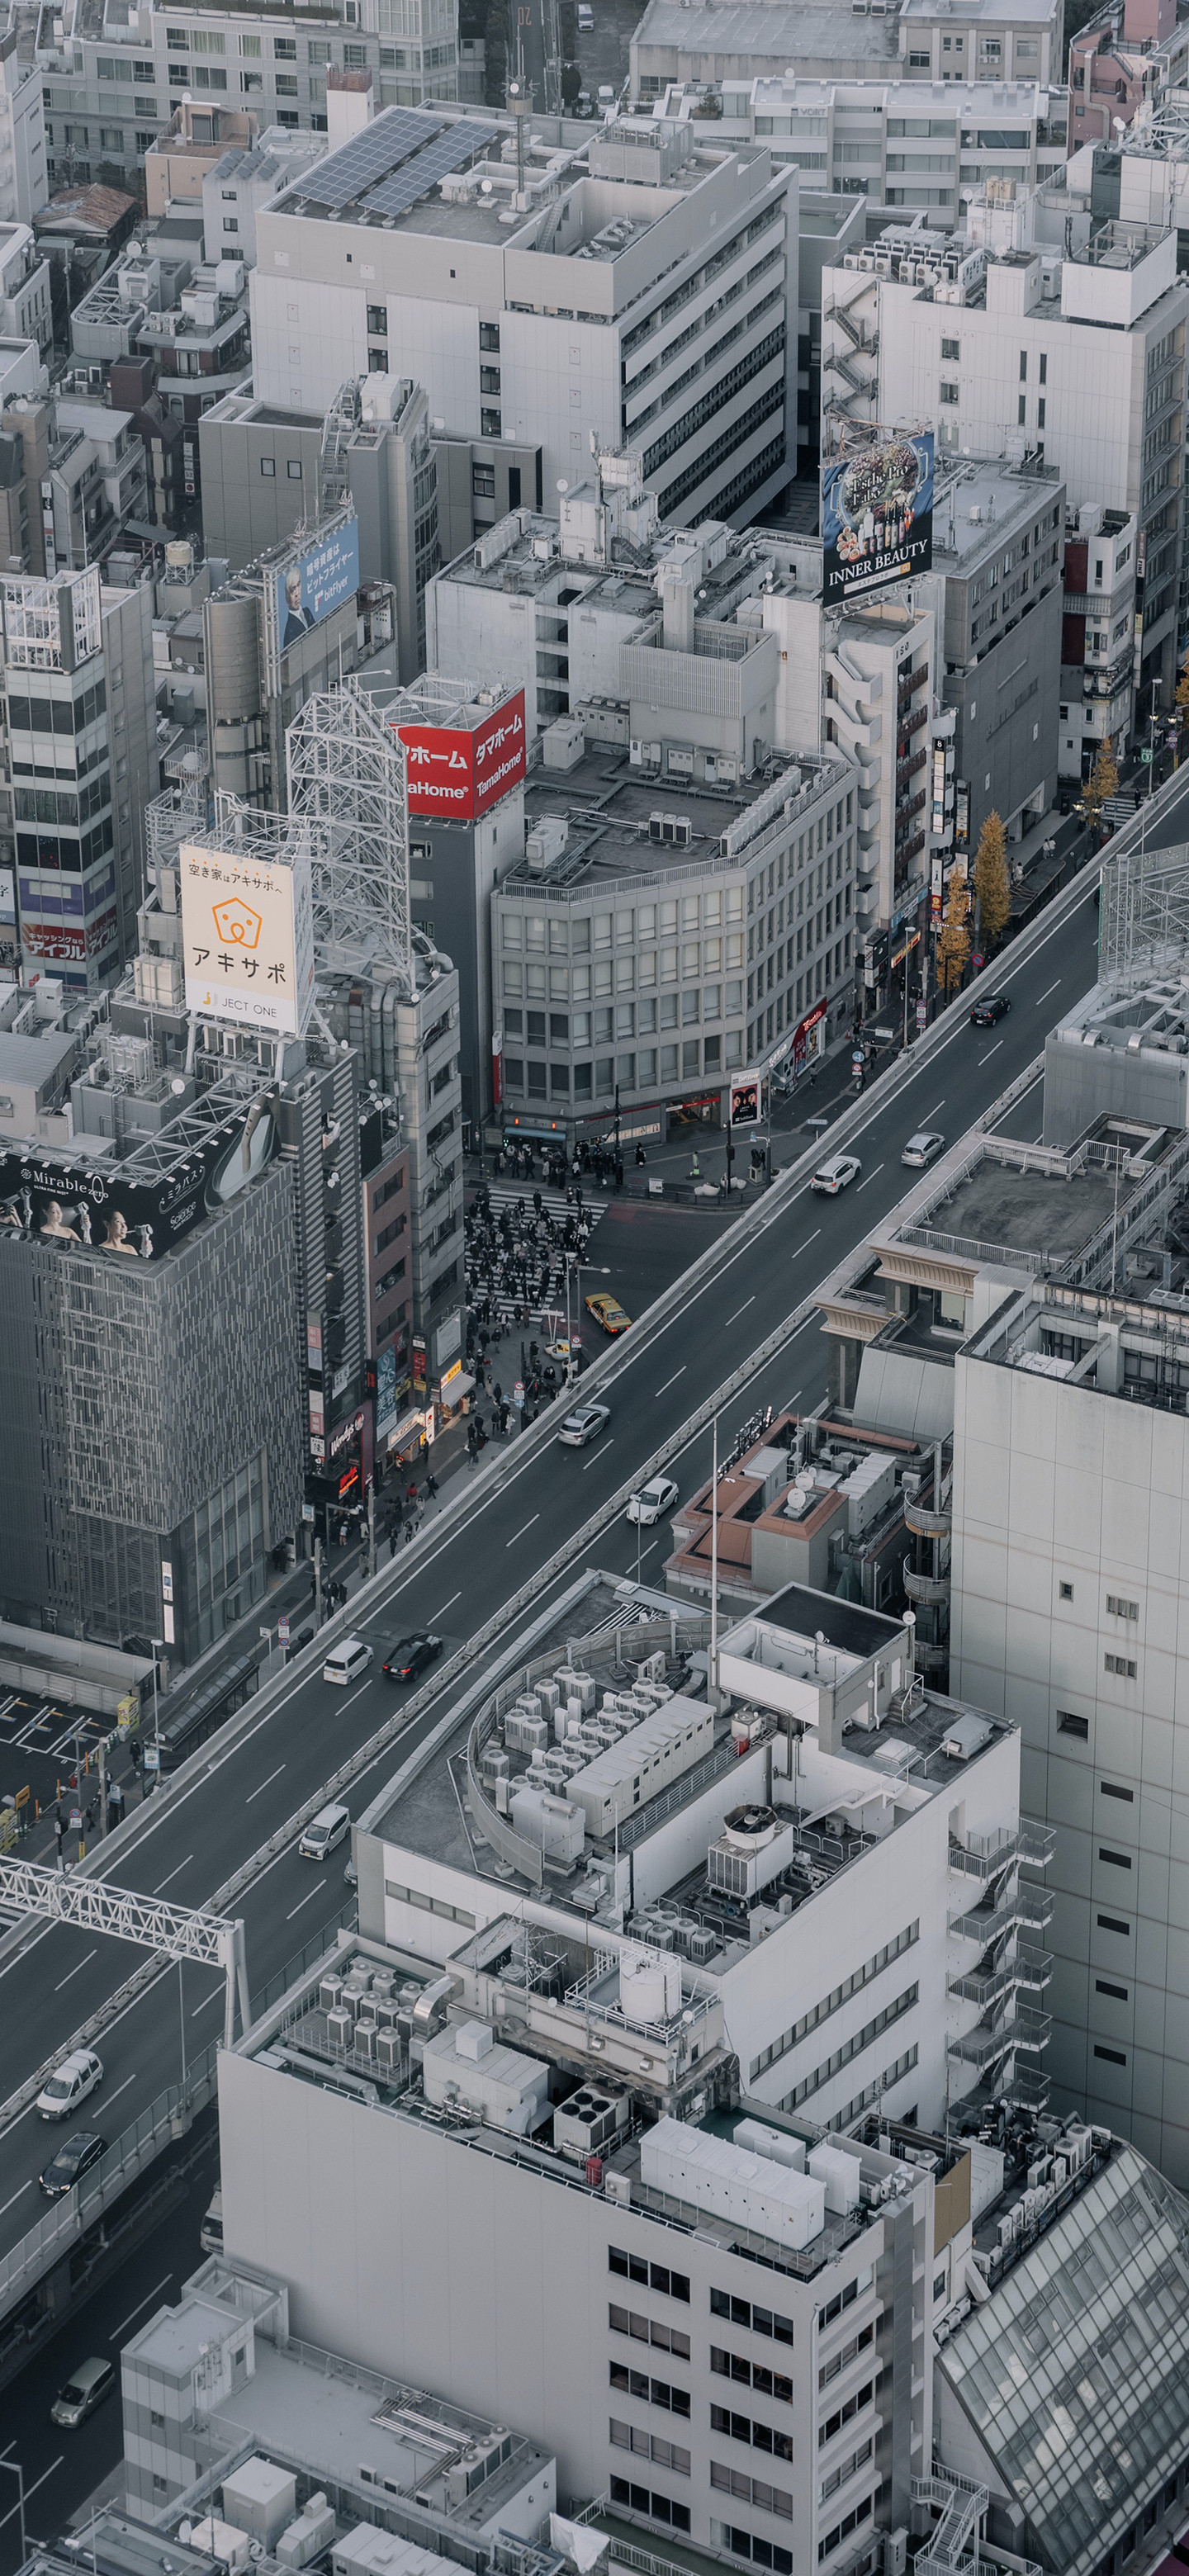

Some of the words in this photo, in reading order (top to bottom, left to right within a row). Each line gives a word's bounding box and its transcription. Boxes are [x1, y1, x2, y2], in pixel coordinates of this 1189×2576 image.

[306, 552, 353, 594] ビットフライヤー
[828, 561, 873, 587] INNER
[875, 539, 928, 568] BEAUTY
[324, 575, 348, 602] bitFlyer
[476, 713, 523, 766] タマホーム
[189, 864, 283, 894] 空き家はアキサポへ
[29, 933, 84, 945] キャッシングなら
[29, 940, 86, 960] アイフル
[192, 947, 286, 984] アキサポ
[222, 997, 249, 1011] JECT
[253, 1004, 277, 1018] ONE
[34, 1171, 88, 1193] Mirable
